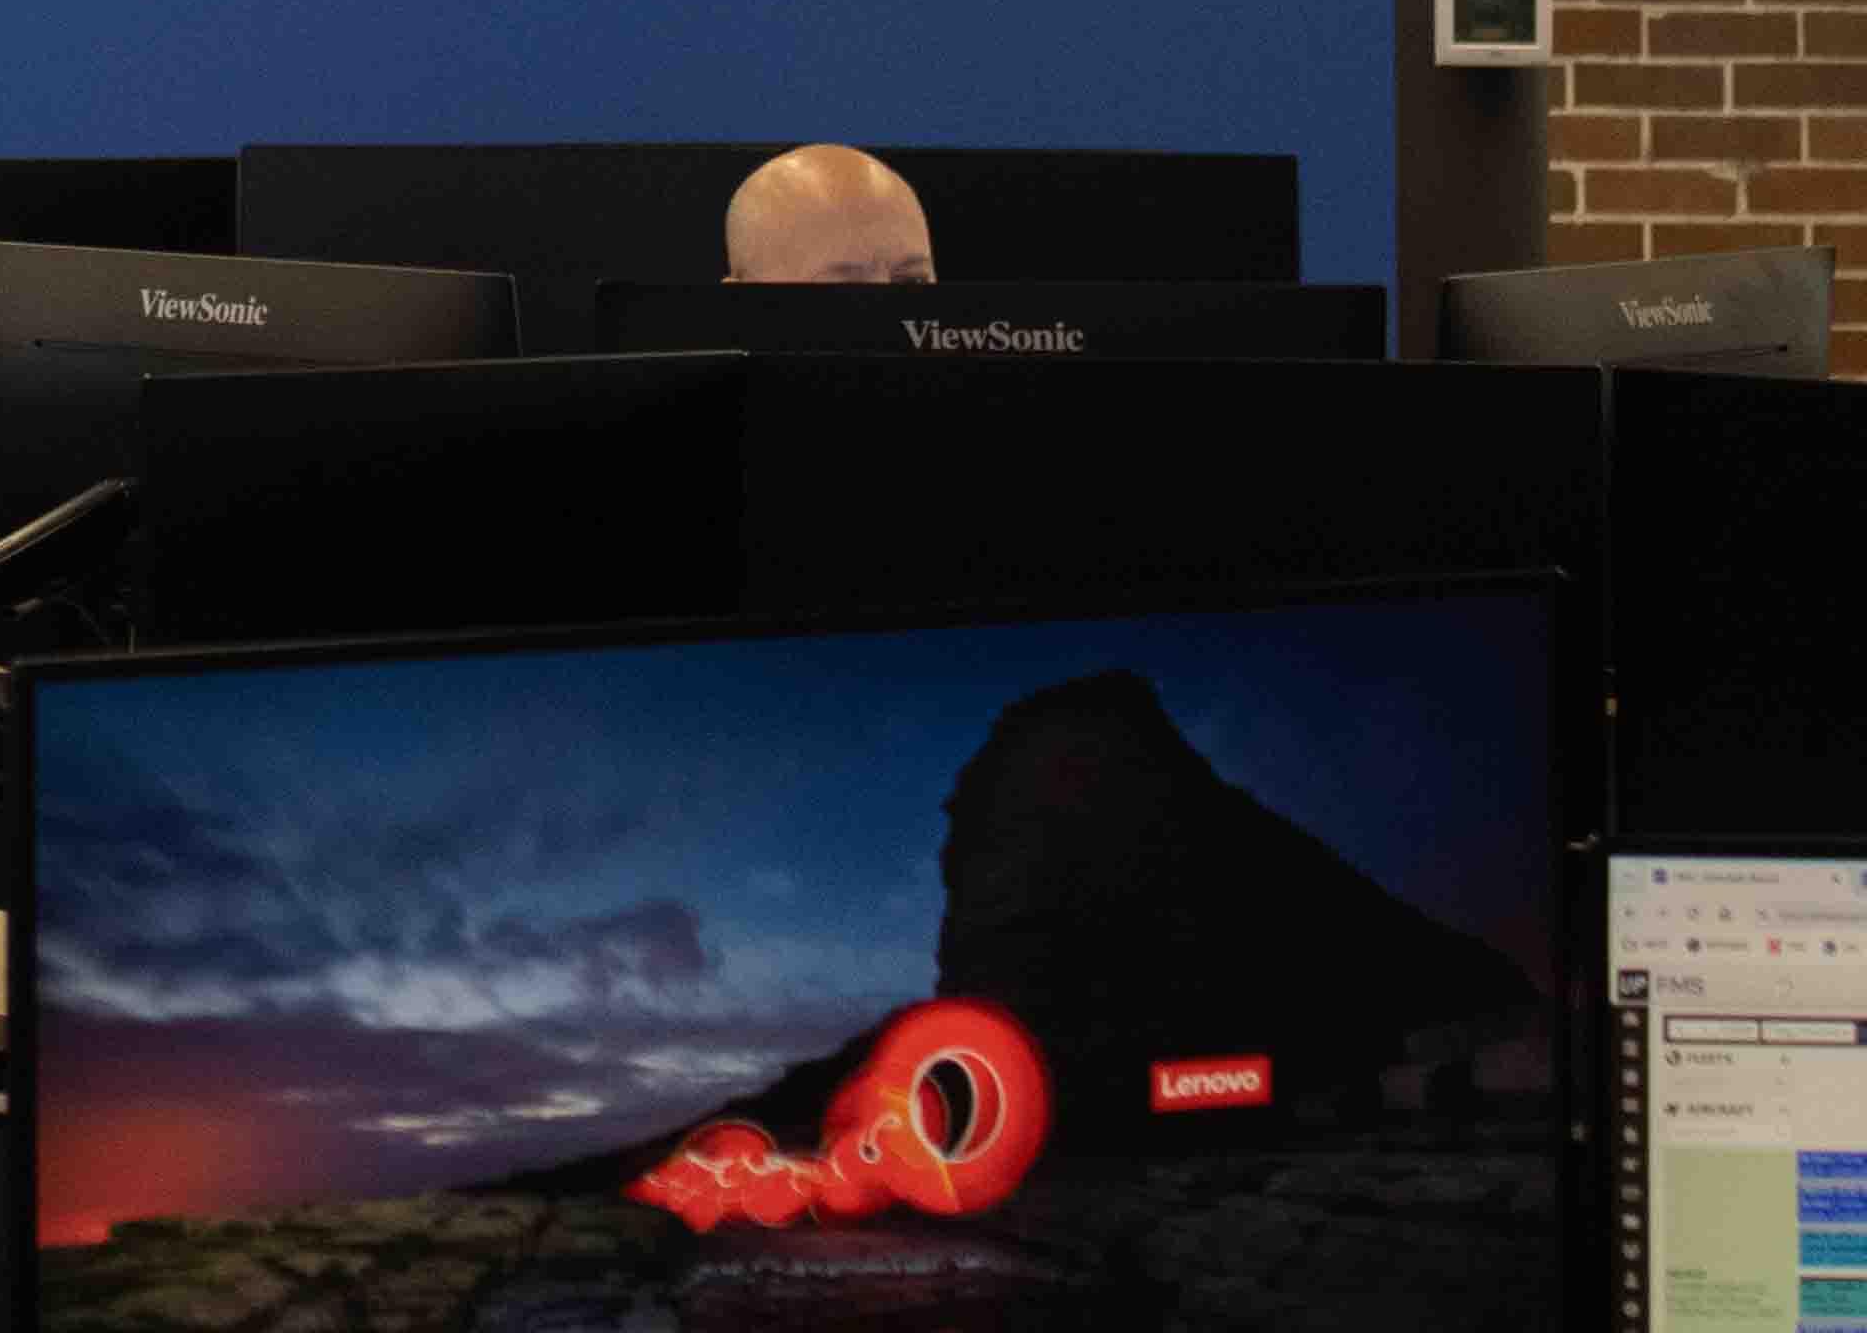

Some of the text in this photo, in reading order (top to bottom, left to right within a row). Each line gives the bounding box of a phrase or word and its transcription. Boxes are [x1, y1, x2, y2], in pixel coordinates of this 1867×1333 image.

[139, 287, 268, 326] ViewSonic
[1619, 293, 1714, 328] ViewSonic
[901, 318, 1084, 354] ViewSonic
[1161, 1069, 1260, 1100] Lenovo
